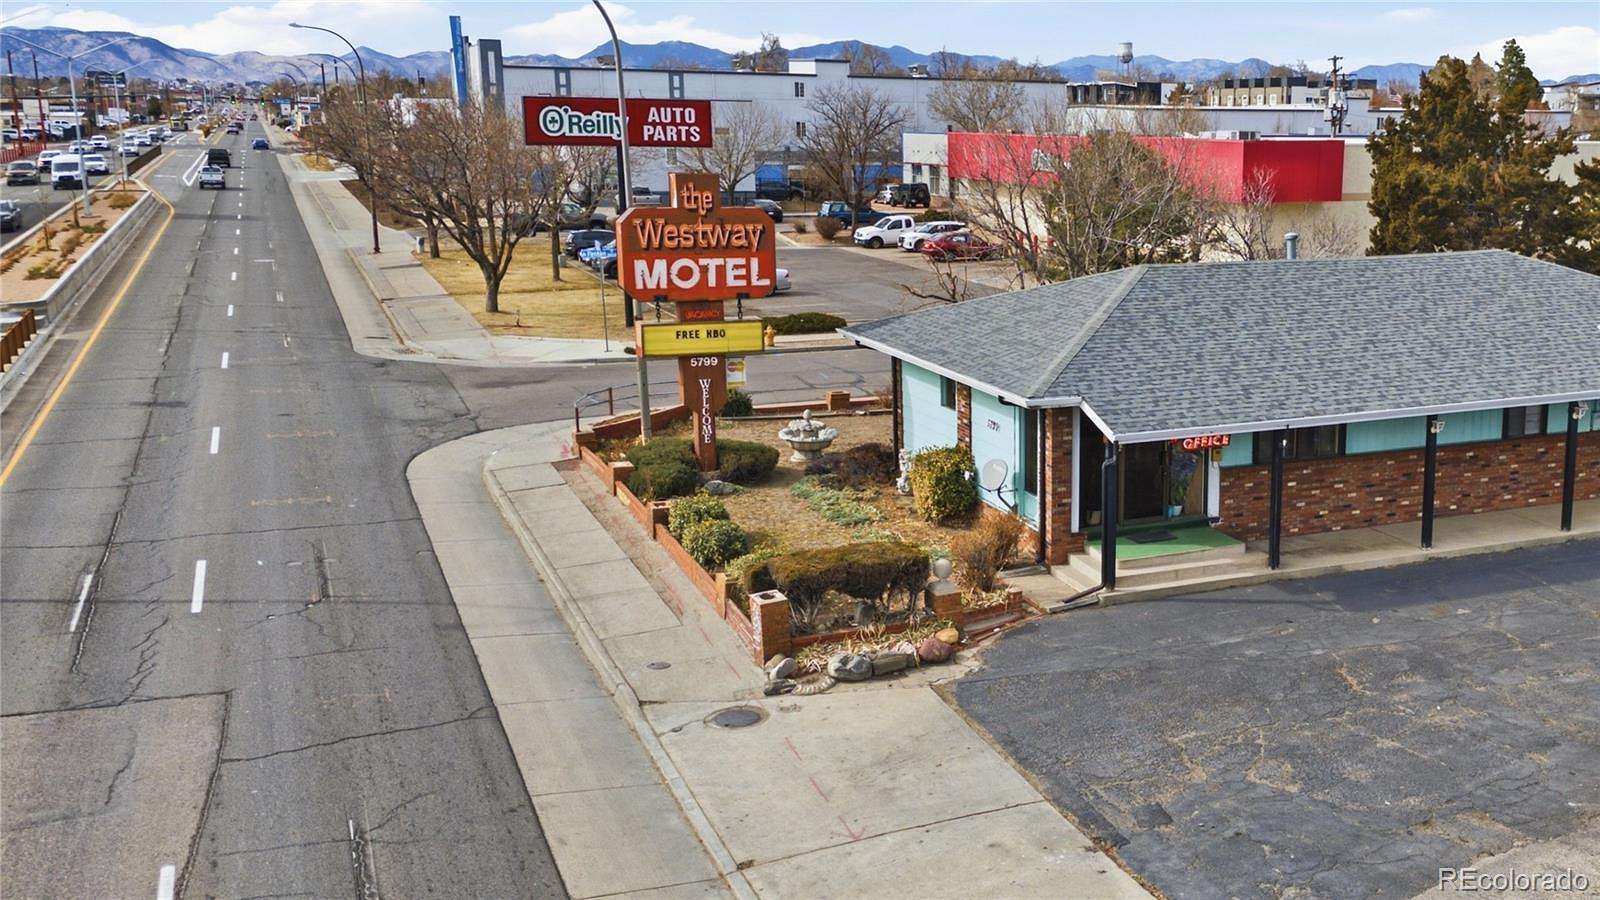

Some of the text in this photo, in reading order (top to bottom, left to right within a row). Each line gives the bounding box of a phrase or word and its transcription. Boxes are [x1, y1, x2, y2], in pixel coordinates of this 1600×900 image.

[648, 107, 695, 123] AUTO
[643, 126, 700, 142] PARTS
[681, 182, 713, 215] the
[633, 217, 764, 253] Westway
[634, 257, 770, 289] MOTEL
[675, 328, 726, 339] FREE HBO
[690, 357, 718, 367] 5799
[699, 379, 713, 444] WELCOME
[1183, 434, 1229, 450] OFFICE
